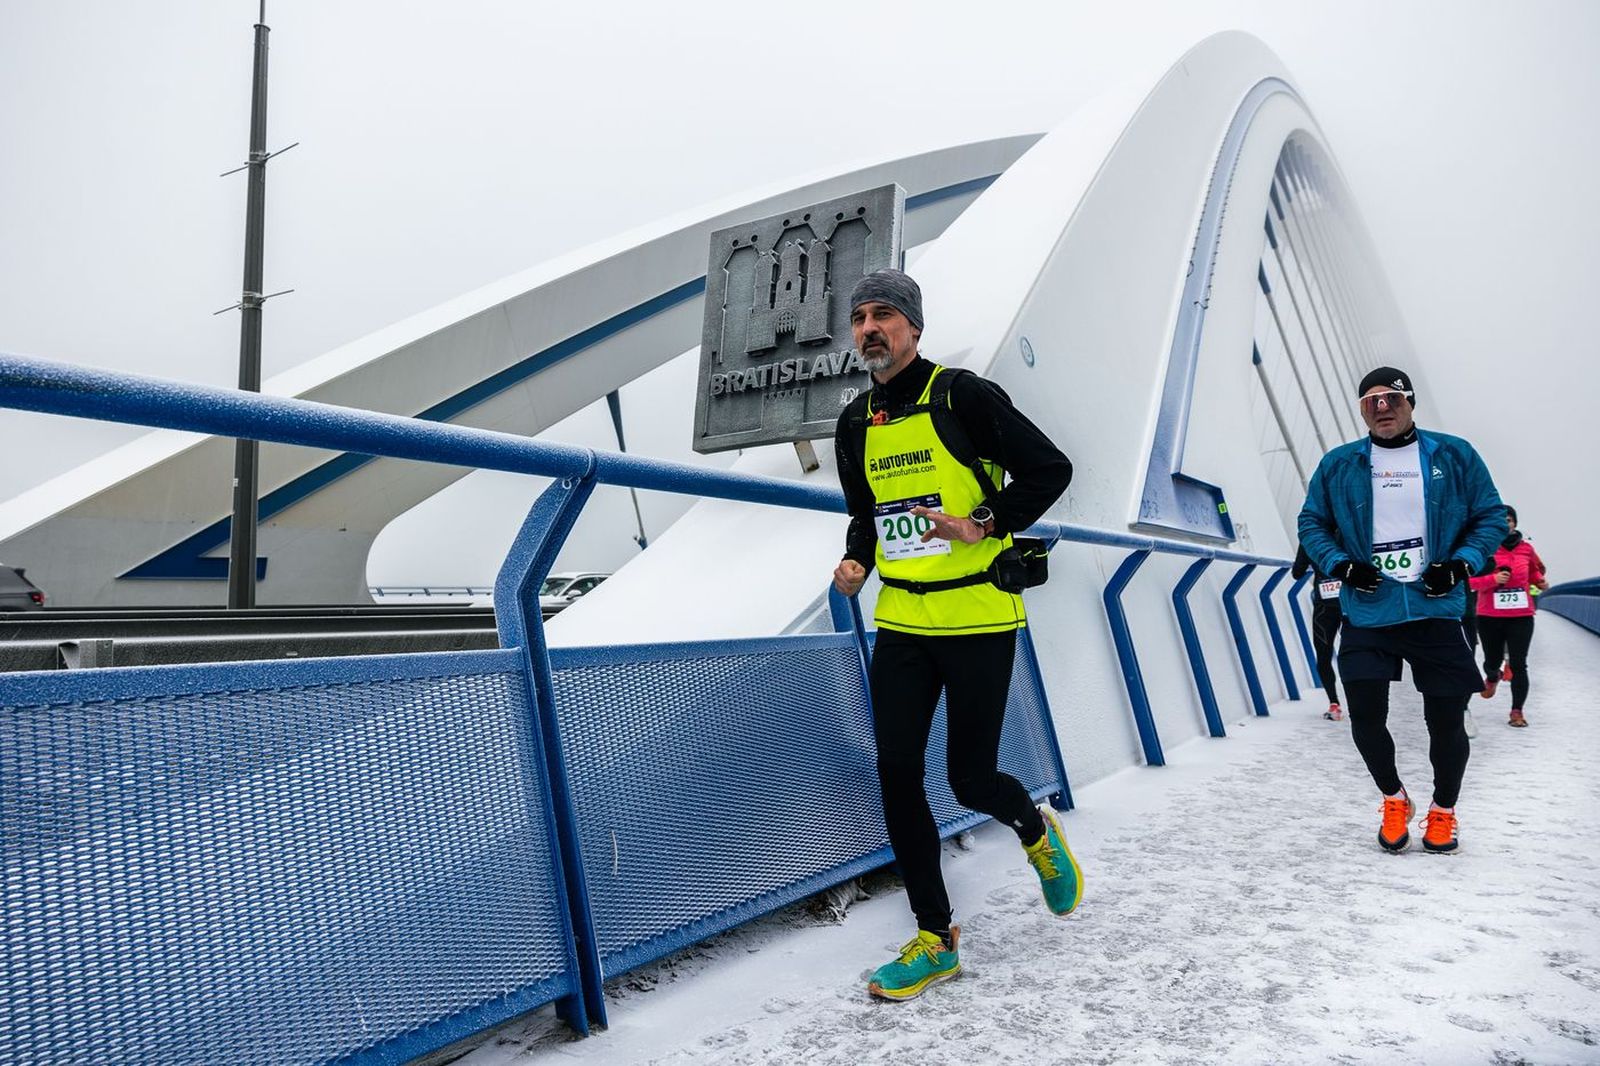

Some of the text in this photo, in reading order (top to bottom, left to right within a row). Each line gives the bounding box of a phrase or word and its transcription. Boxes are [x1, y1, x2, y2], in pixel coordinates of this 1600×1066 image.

[711, 350, 866, 396] BRATISLAVA
[883, 516, 930, 541] 200
[1372, 552, 1411, 570] 366
[1500, 594, 1518, 602] 273
